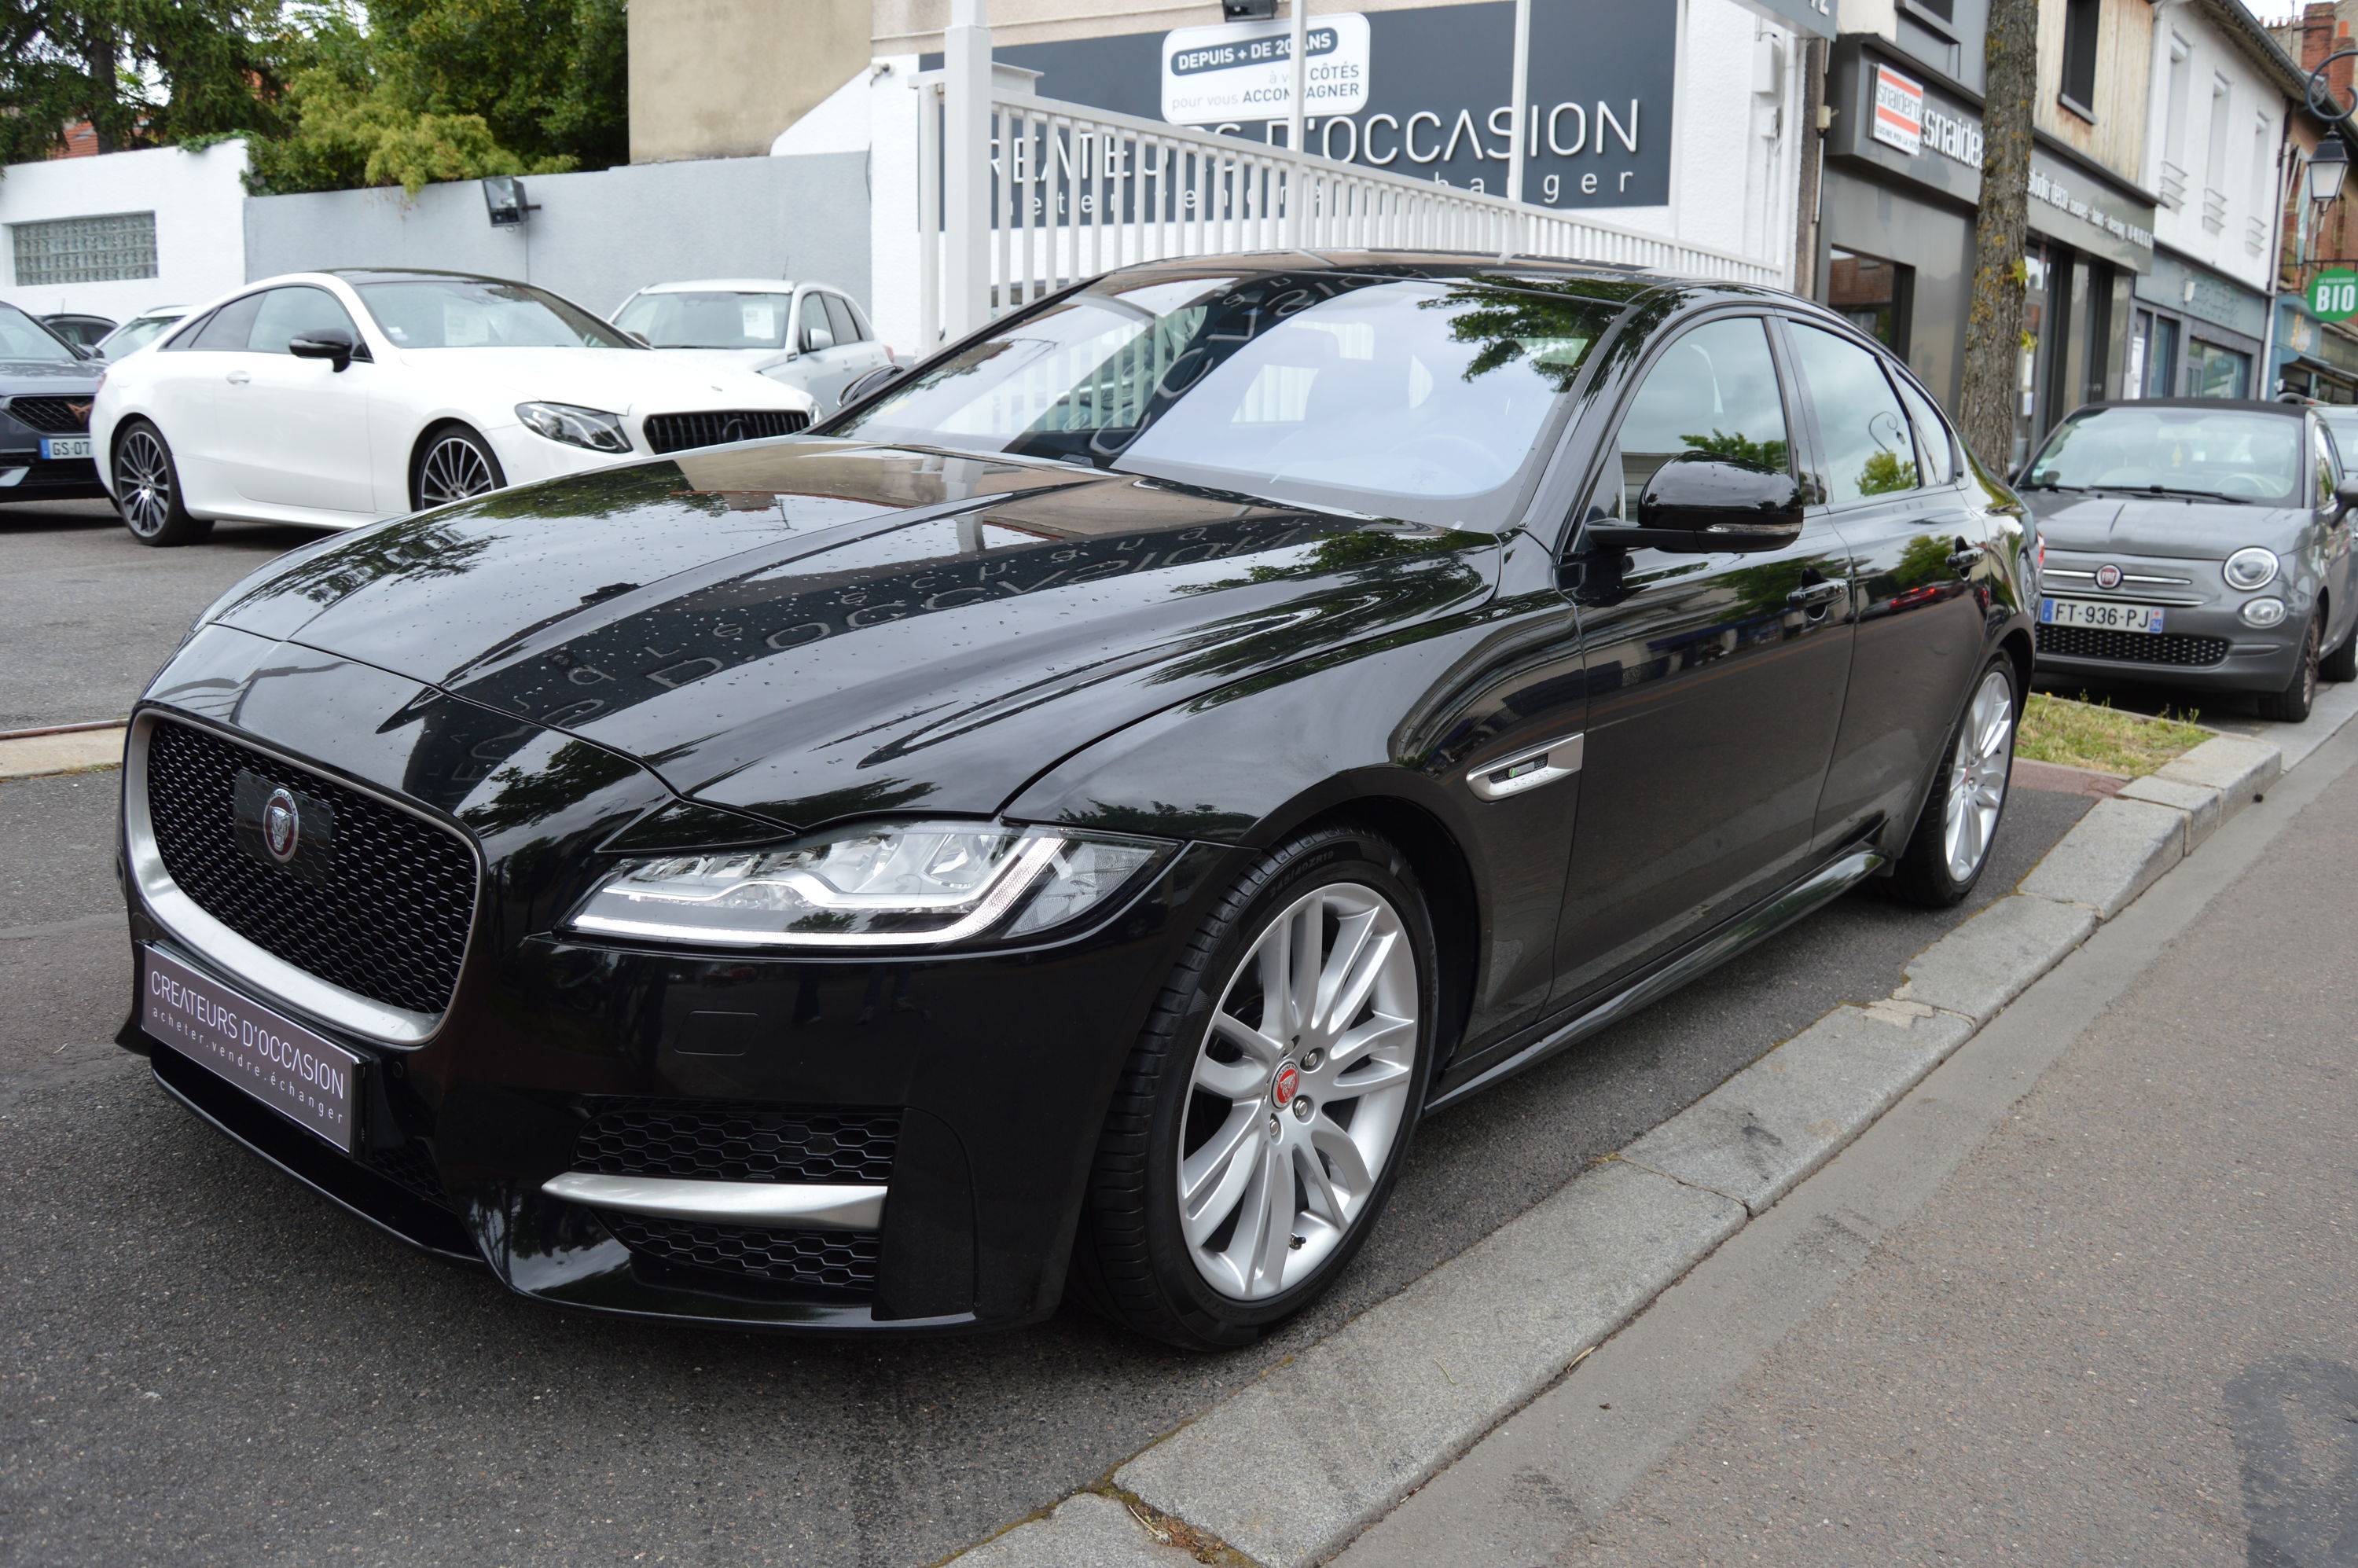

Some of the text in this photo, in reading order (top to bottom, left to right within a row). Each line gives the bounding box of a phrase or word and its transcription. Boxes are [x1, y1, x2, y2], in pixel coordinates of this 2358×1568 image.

[1178, 47, 1235, 70] DEPUIS
[1237, 49, 1247, 61] +
[1251, 42, 1272, 60] DE
[1310, 61, 1360, 81] CÔTÉS
[1172, 95, 1203, 112] pour
[1207, 94, 1239, 106] vous
[2316, 285, 2356, 313] BIO
[2054, 603, 2150, 629] FT-936-PJ
[152, 971, 343, 1100] CREATEURS D'OCCASION
